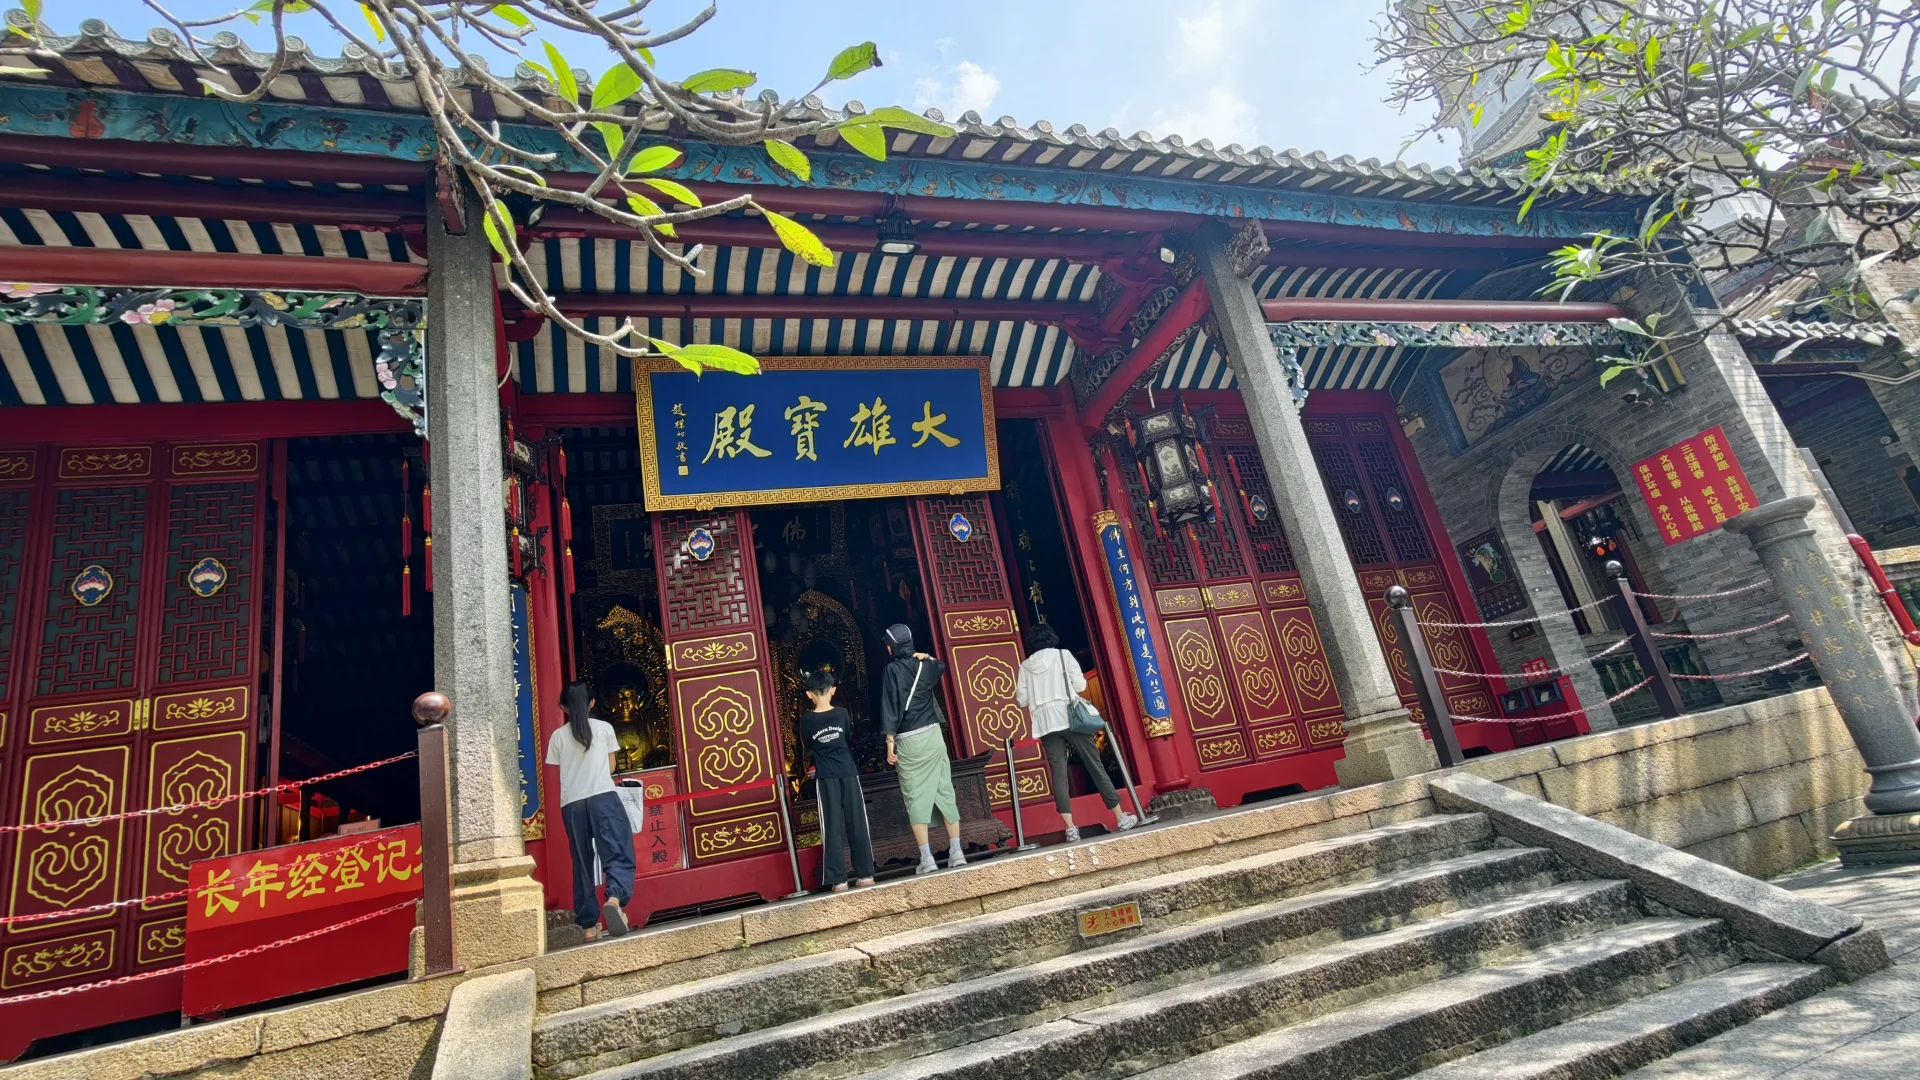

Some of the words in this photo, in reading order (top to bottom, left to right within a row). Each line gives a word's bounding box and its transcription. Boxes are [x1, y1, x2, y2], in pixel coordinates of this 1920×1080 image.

[702, 396, 961, 465] 大雄寶殿
[1638, 464, 1662, 499] 保护环境
[1657, 504, 1682, 540] 净化心灵
[1659, 454, 1683, 489] 文明敬香
[1679, 495, 1704, 532] 从我做起
[1701, 485, 1728, 524] 诚心感应
[1703, 434, 1730, 471] 所求如愿
[1724, 475, 1751, 513] 吉祥平安
[648, 804, 668, 864] 禁止入殿
[196, 839, 424, 918] 长年经登记
